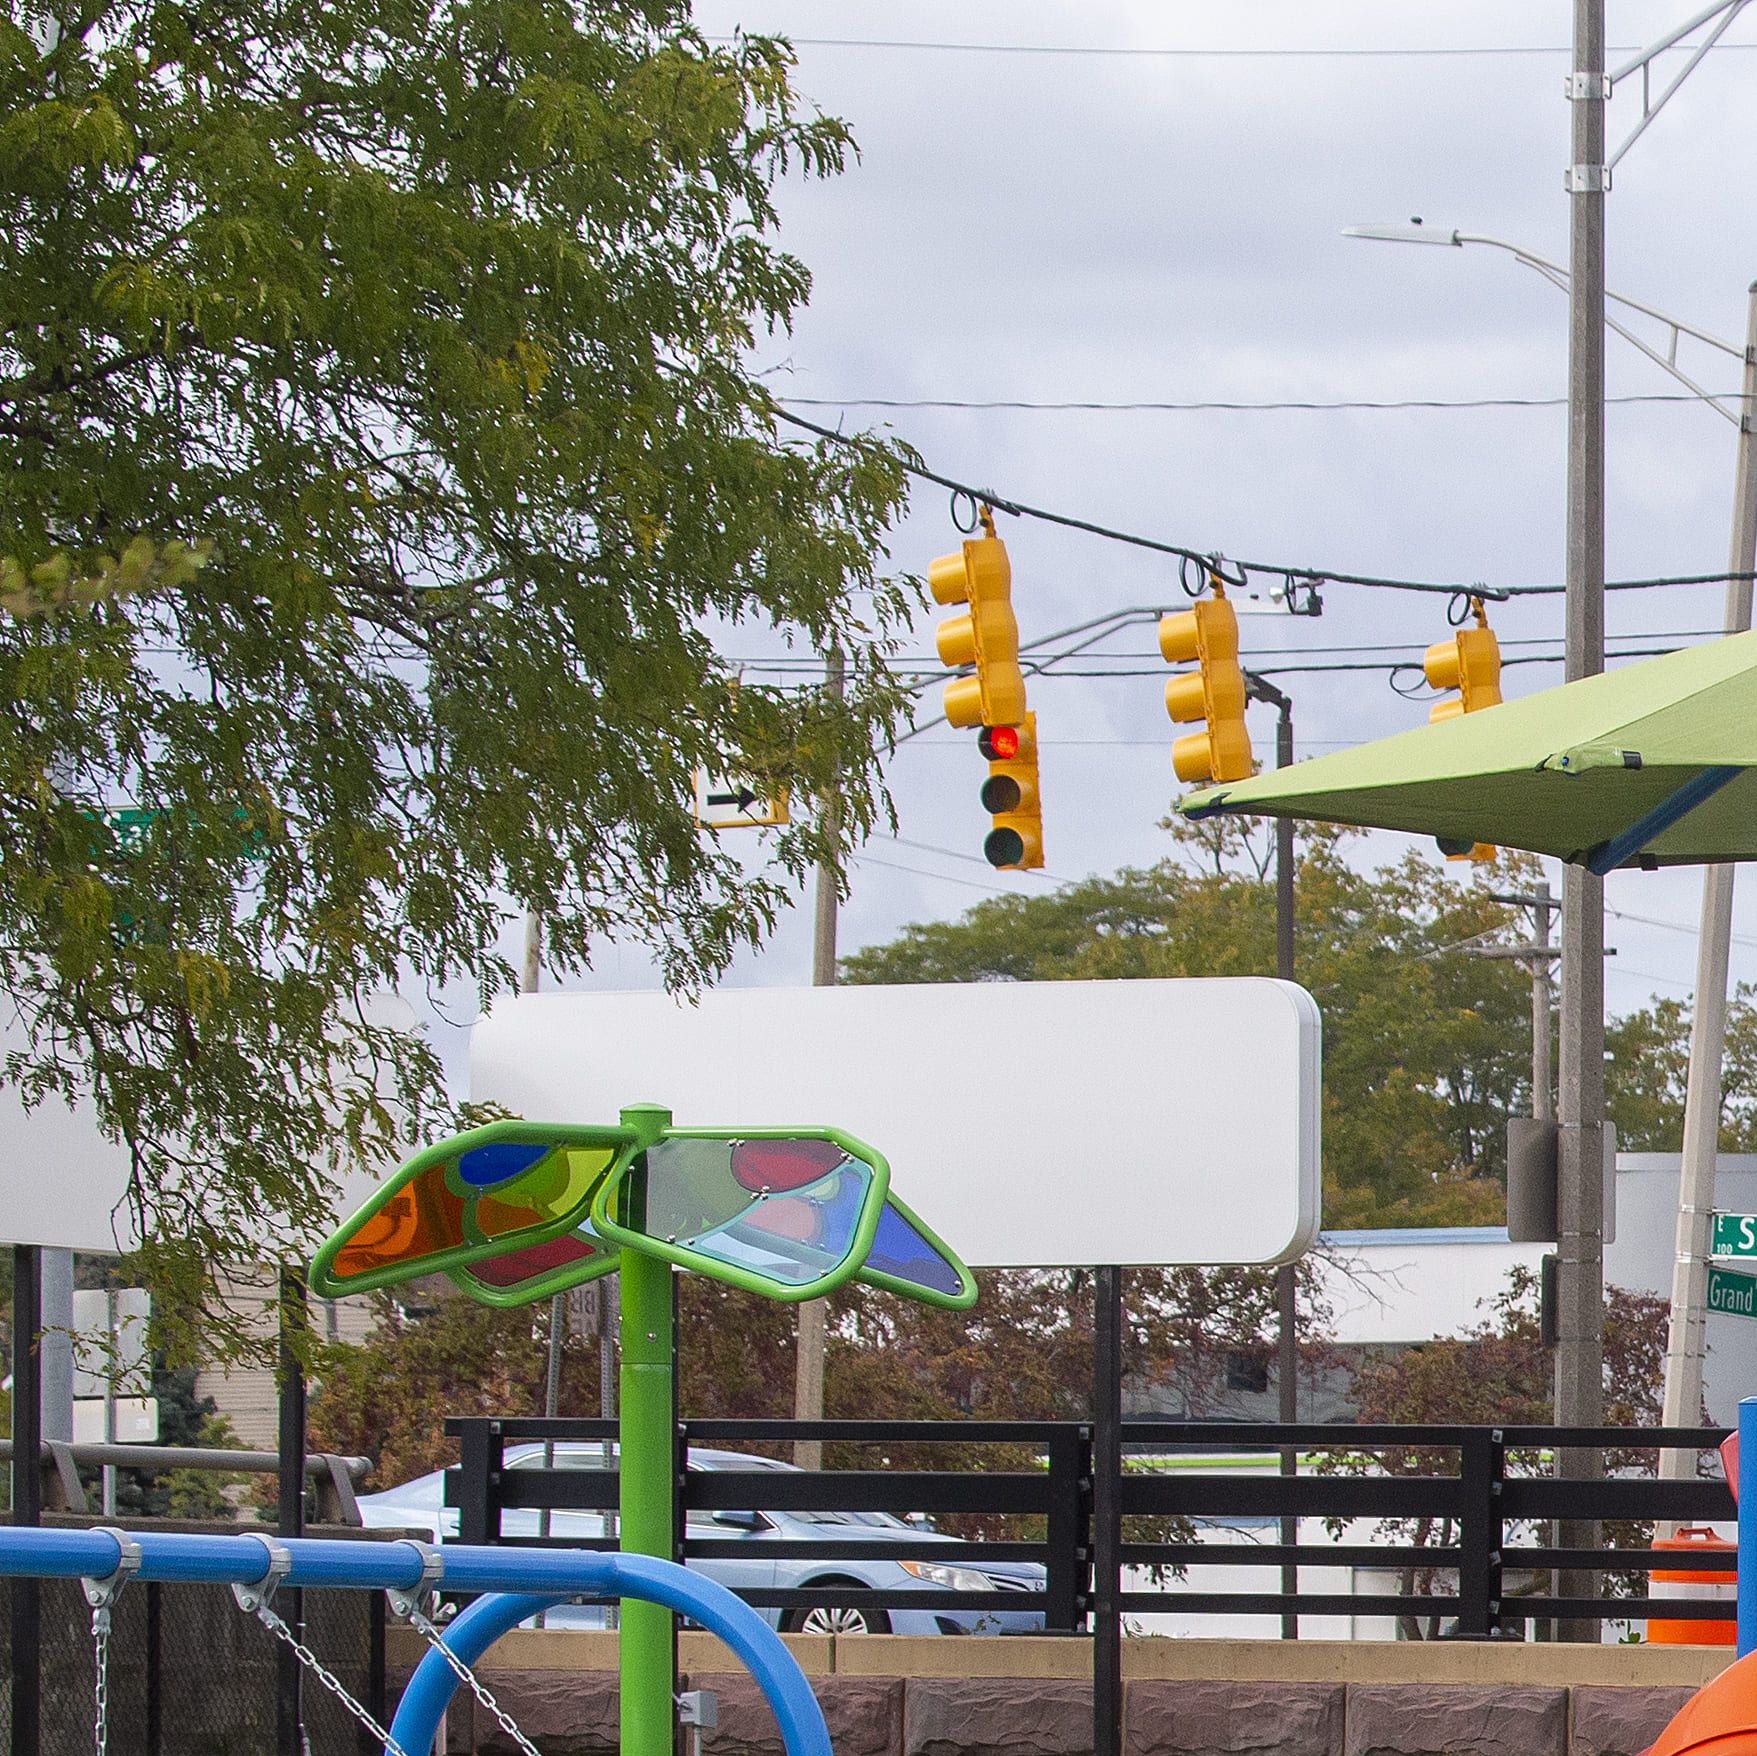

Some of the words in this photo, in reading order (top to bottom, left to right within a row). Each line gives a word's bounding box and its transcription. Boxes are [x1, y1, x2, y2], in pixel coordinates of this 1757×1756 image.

[1717, 1215, 1724, 1232] E
[1716, 1243, 1733, 1255] 100
[1710, 1275, 1753, 1312] Grand
